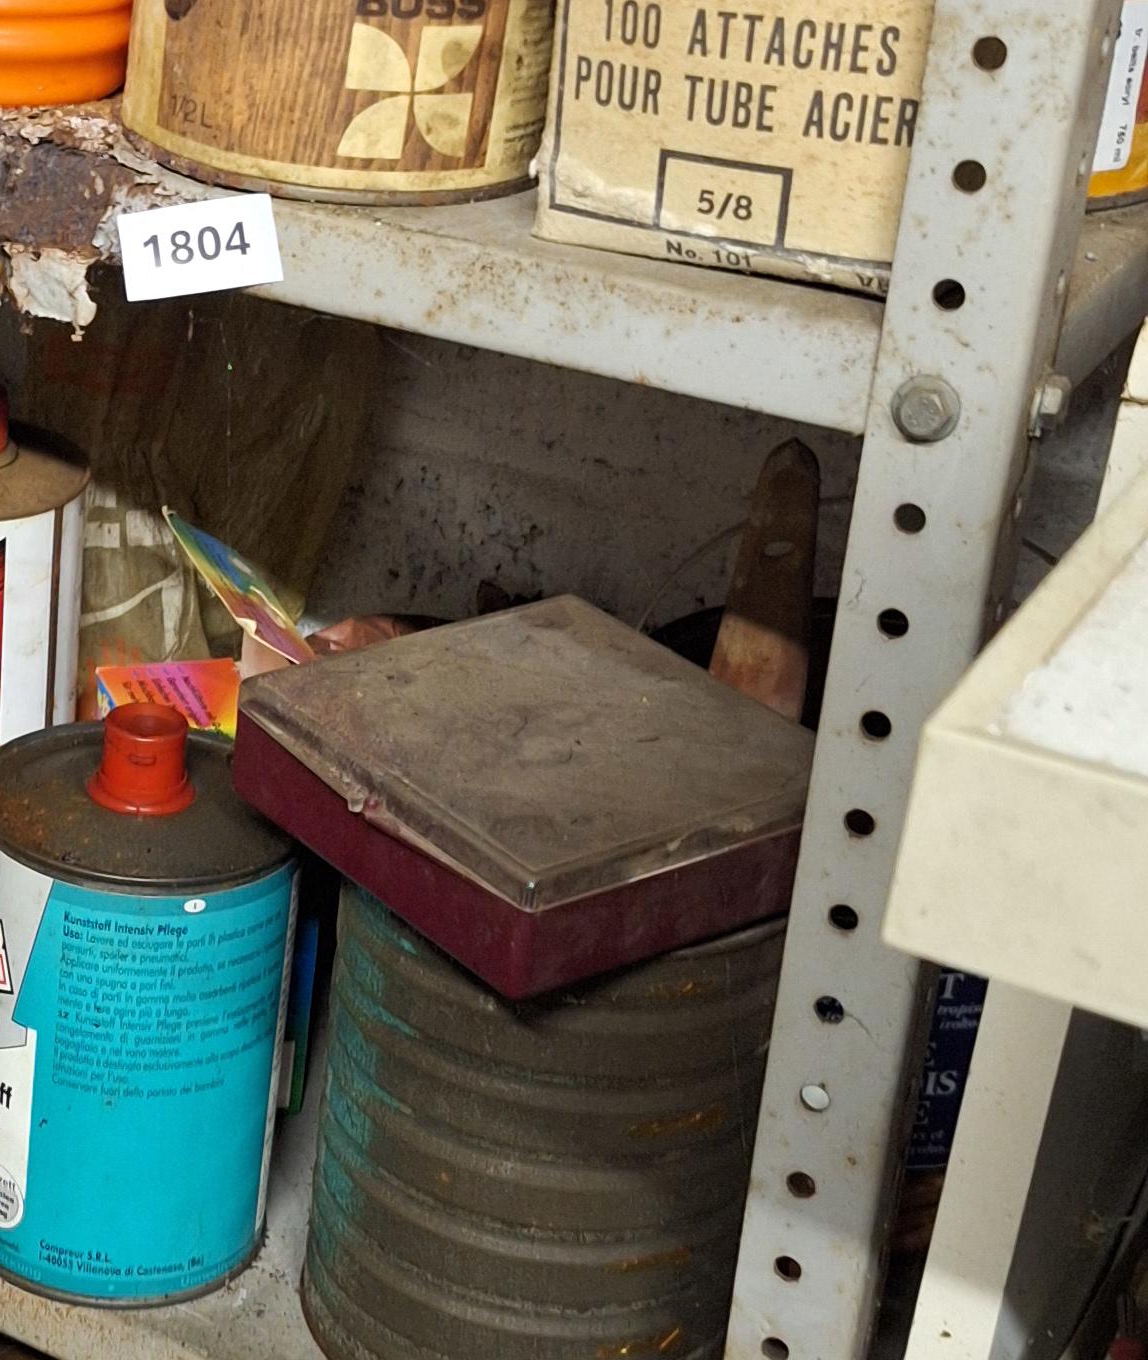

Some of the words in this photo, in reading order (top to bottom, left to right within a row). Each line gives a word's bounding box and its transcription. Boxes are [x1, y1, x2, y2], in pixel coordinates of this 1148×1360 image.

[688, 9, 901, 77] ATTACHES
[574, 56, 660, 117] POUR
[684, 74, 775, 133] TUBE
[802, 89, 919, 149] ACIER
[697, 189, 754, 222] 5/8
[142, 221, 251, 269] 1804
[665, 239, 704, 263] No.
[62, 924, 83, 940] Uso:
[63, 909, 112, 932] Kunststoff
[114, 920, 155, 936] Intensiv
[157, 924, 189, 937] Pflege
